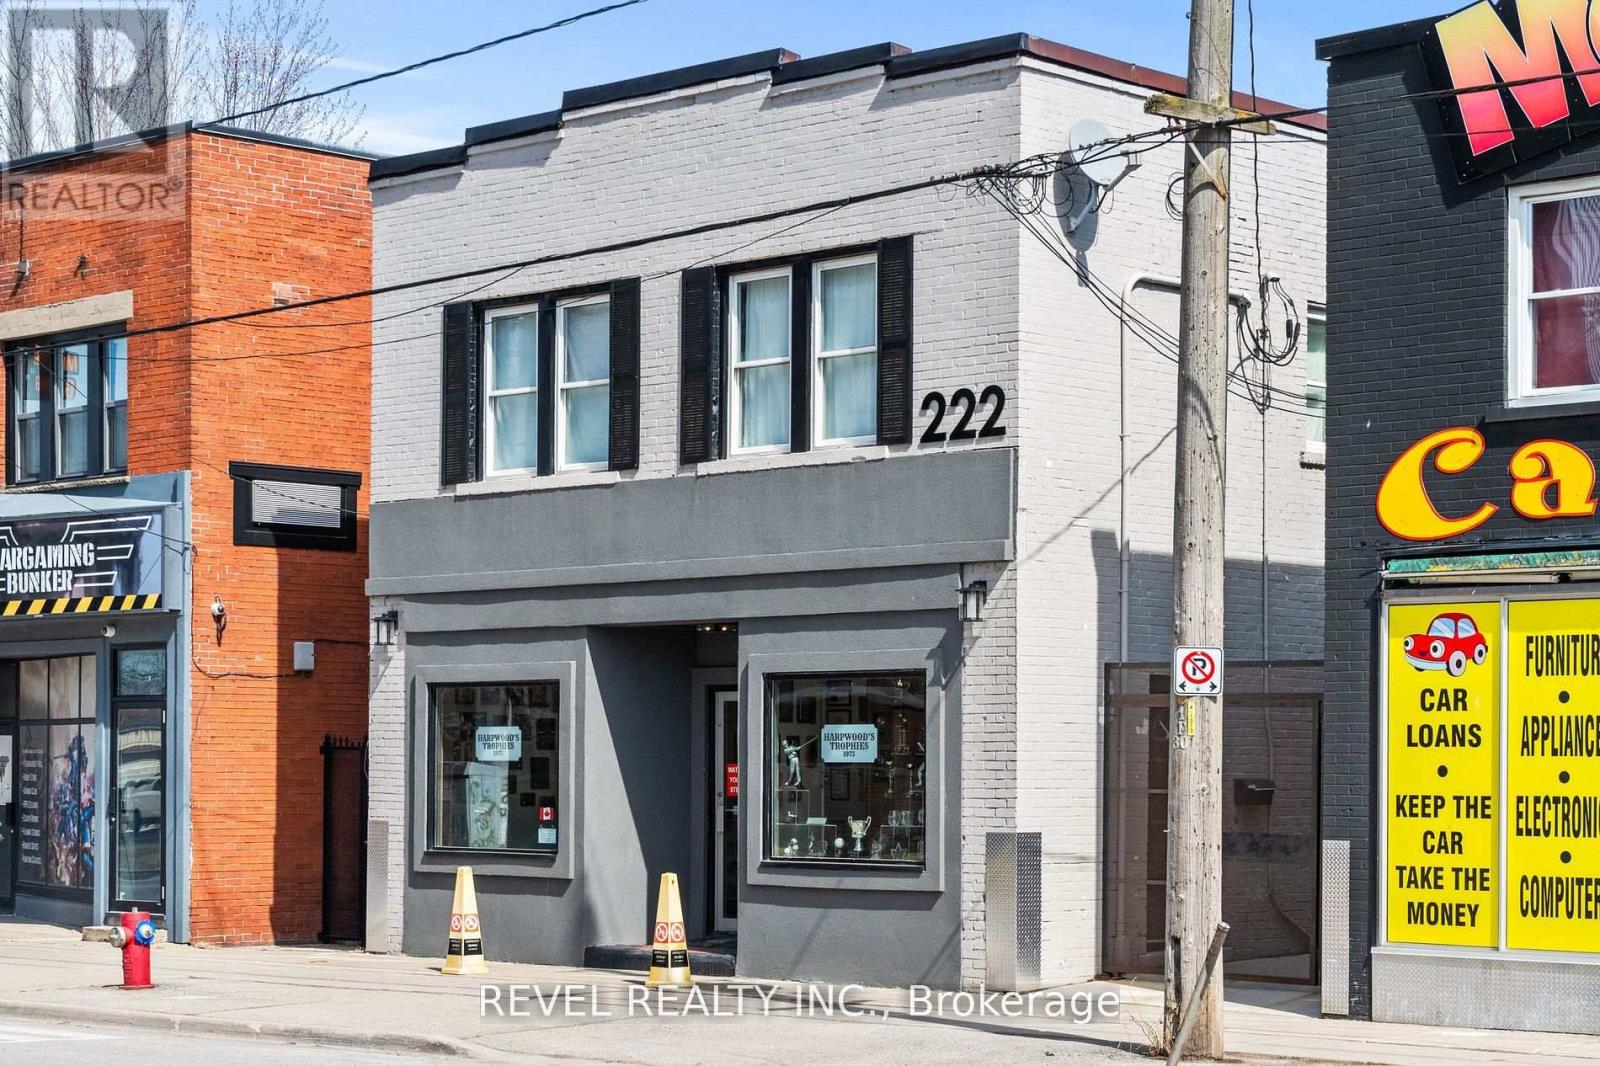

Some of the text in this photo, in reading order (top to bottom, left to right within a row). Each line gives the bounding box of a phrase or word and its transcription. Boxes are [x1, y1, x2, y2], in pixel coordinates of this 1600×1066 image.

[920, 384, 1006, 443] 222
[7, 569, 73, 595] BUNKER
[1420, 688, 1468, 712] CAR
[823, 732, 876, 742] HARPWOOD'S
[829, 741, 869, 751] TROPHIES
[1407, 723, 1482, 748] LOANS
[1396, 795, 1492, 819] KEEP THE
[1516, 795, 1600, 838] ELECTRONI
[1423, 830, 1463, 854] CAR
[1396, 866, 1490, 891] TAKE THE
[1408, 901, 1480, 927] MONEY
